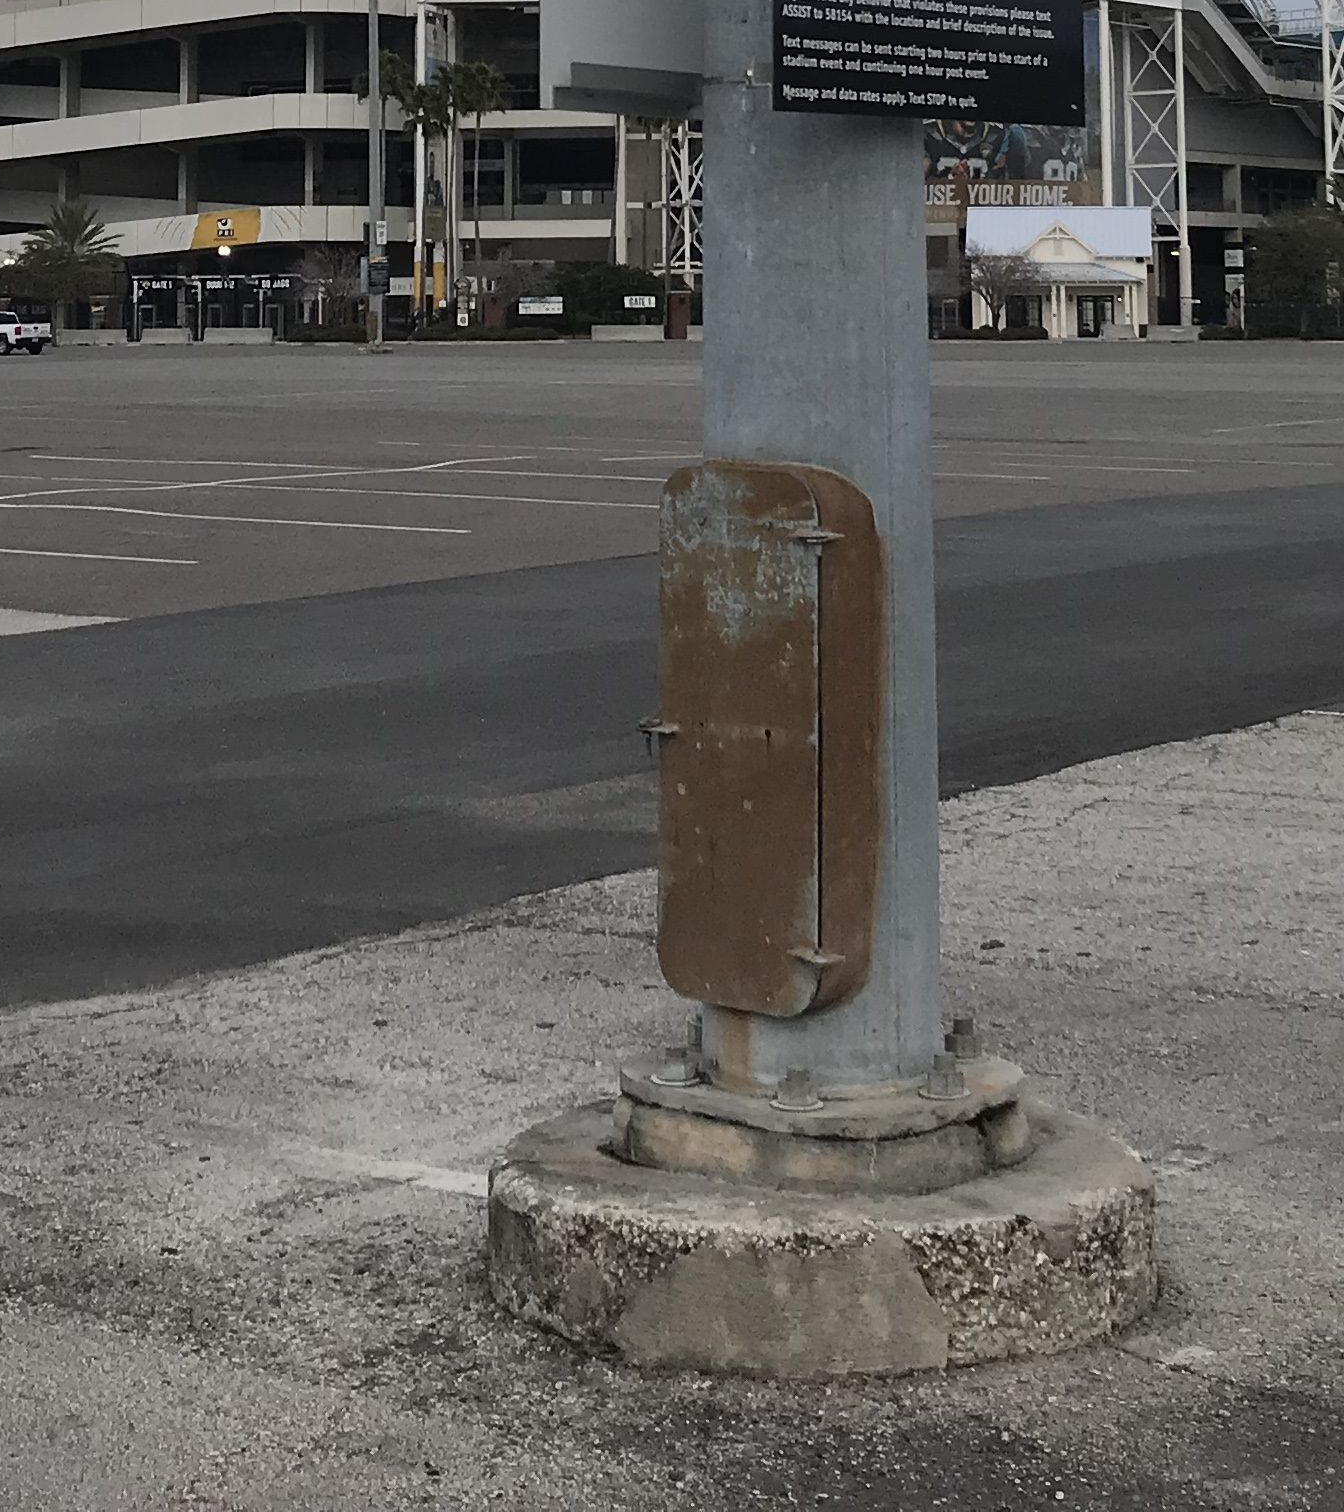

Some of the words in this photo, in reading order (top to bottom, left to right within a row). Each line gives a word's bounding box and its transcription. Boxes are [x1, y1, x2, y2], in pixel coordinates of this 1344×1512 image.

[782, 3, 811, 18] ASSIST
[813, 7, 823, 19] to
[825, 7, 852, 21] 58154
[854, 10, 873, 23] with
[874, 12, 889, 25] the
[891, 13, 923, 27] location
[925, 17, 940, 29] and
[942, 17, 962, 30] brief
[963, 20, 1006, 35] description
[1008, 23, 1016, 35] of
[1018, 24, 1031, 37] the
[945, 0, 967, 14] these
[969, 4, 1008, 17] provisions
[1010, 7, 1034, 20] please
[1035, 10, 1051, 21] text
[782, 84, 819, 101] Message
[820, 87, 836, 99] and
[838, 87, 857, 100] data
[859, 90, 880, 102] rates
[908, 91, 925, 104] Text
[926, 92, 946, 105] STOP
[968, 184, 1014, 205] YOUR
[1019, 184, 1073, 206] HOME.
